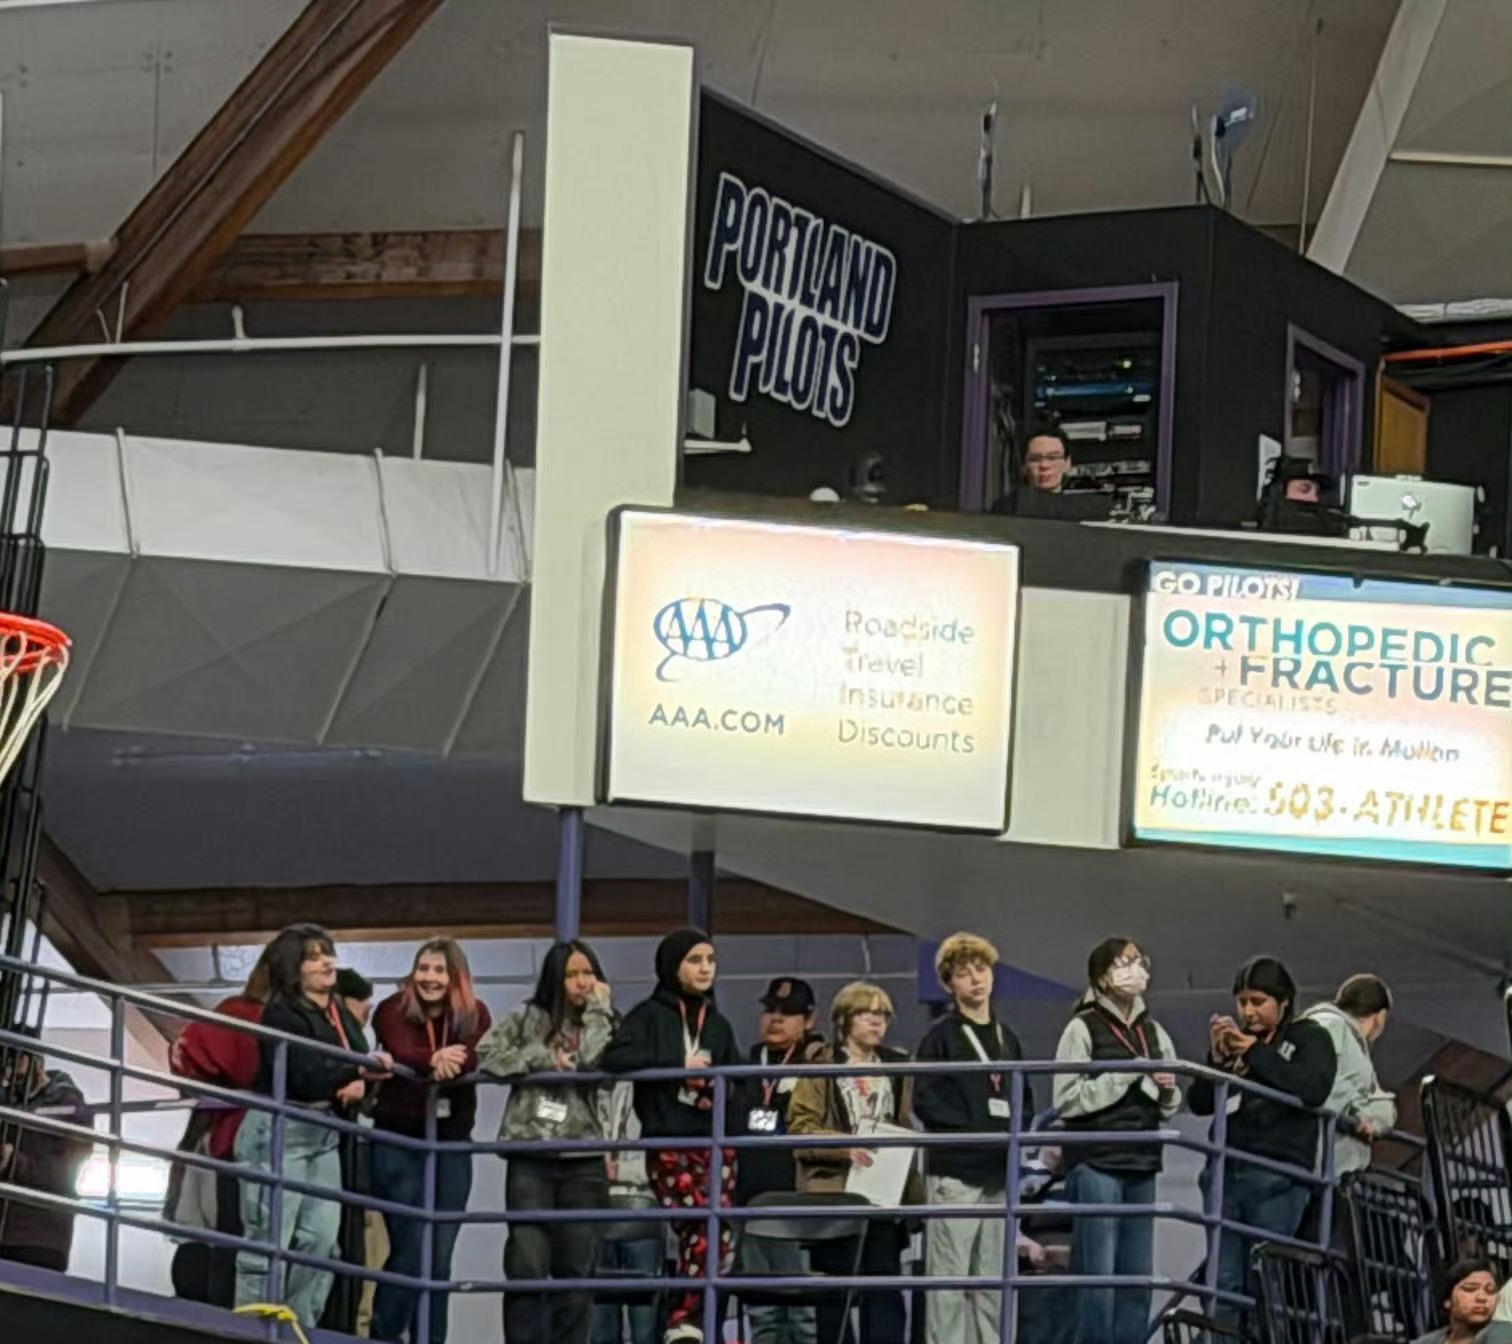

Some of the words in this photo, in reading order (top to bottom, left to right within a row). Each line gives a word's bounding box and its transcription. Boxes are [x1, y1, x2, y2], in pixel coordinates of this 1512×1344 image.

[704, 171, 896, 344] PORTLAND
[729, 288, 860, 427] PILOTS
[1153, 571, 1201, 595] GO
[660, 598, 744, 661] AAA
[844, 609, 975, 645] Roadside
[1162, 608, 1496, 667] ORTHOPEDIC
[842, 645, 924, 678] Travel
[839, 680, 974, 716] Insurance
[1240, 655, 1512, 708] FRACTURE
[648, 702, 786, 735] AAA.COM
[838, 716, 976, 754] Discounts
